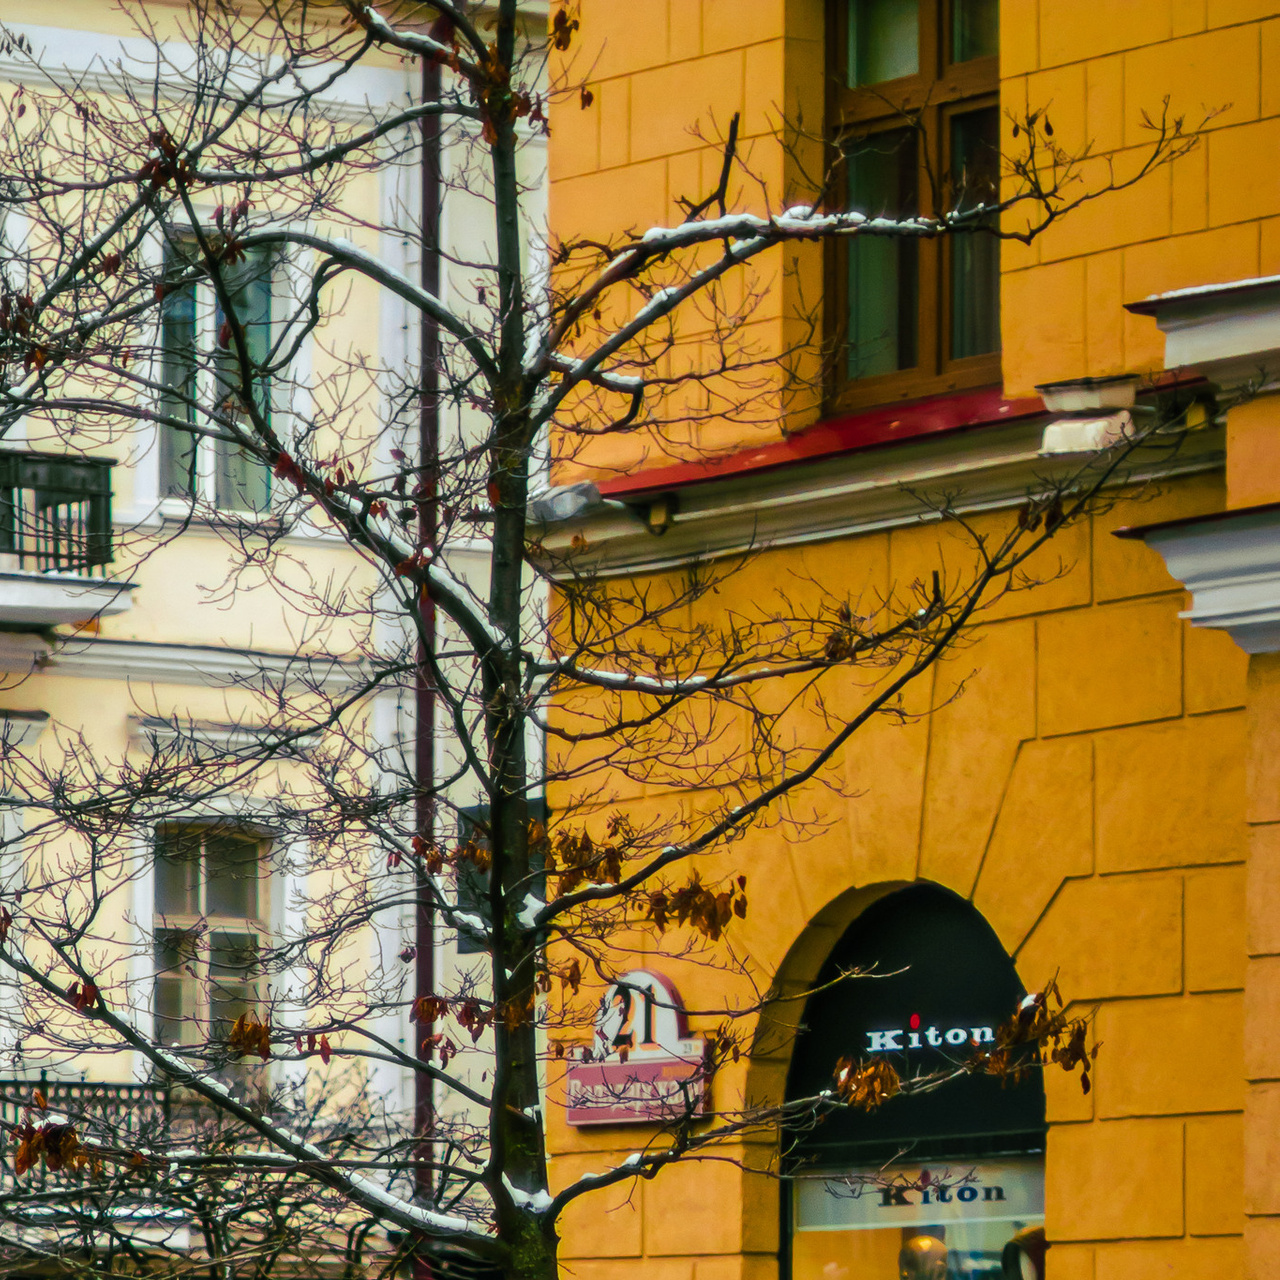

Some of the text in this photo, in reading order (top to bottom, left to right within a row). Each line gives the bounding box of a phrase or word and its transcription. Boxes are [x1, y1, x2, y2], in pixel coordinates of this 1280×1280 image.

[611, 984, 660, 1046] 21
[866, 1013, 995, 1052] Kiton
[877, 1170, 1006, 1207] Kiton
